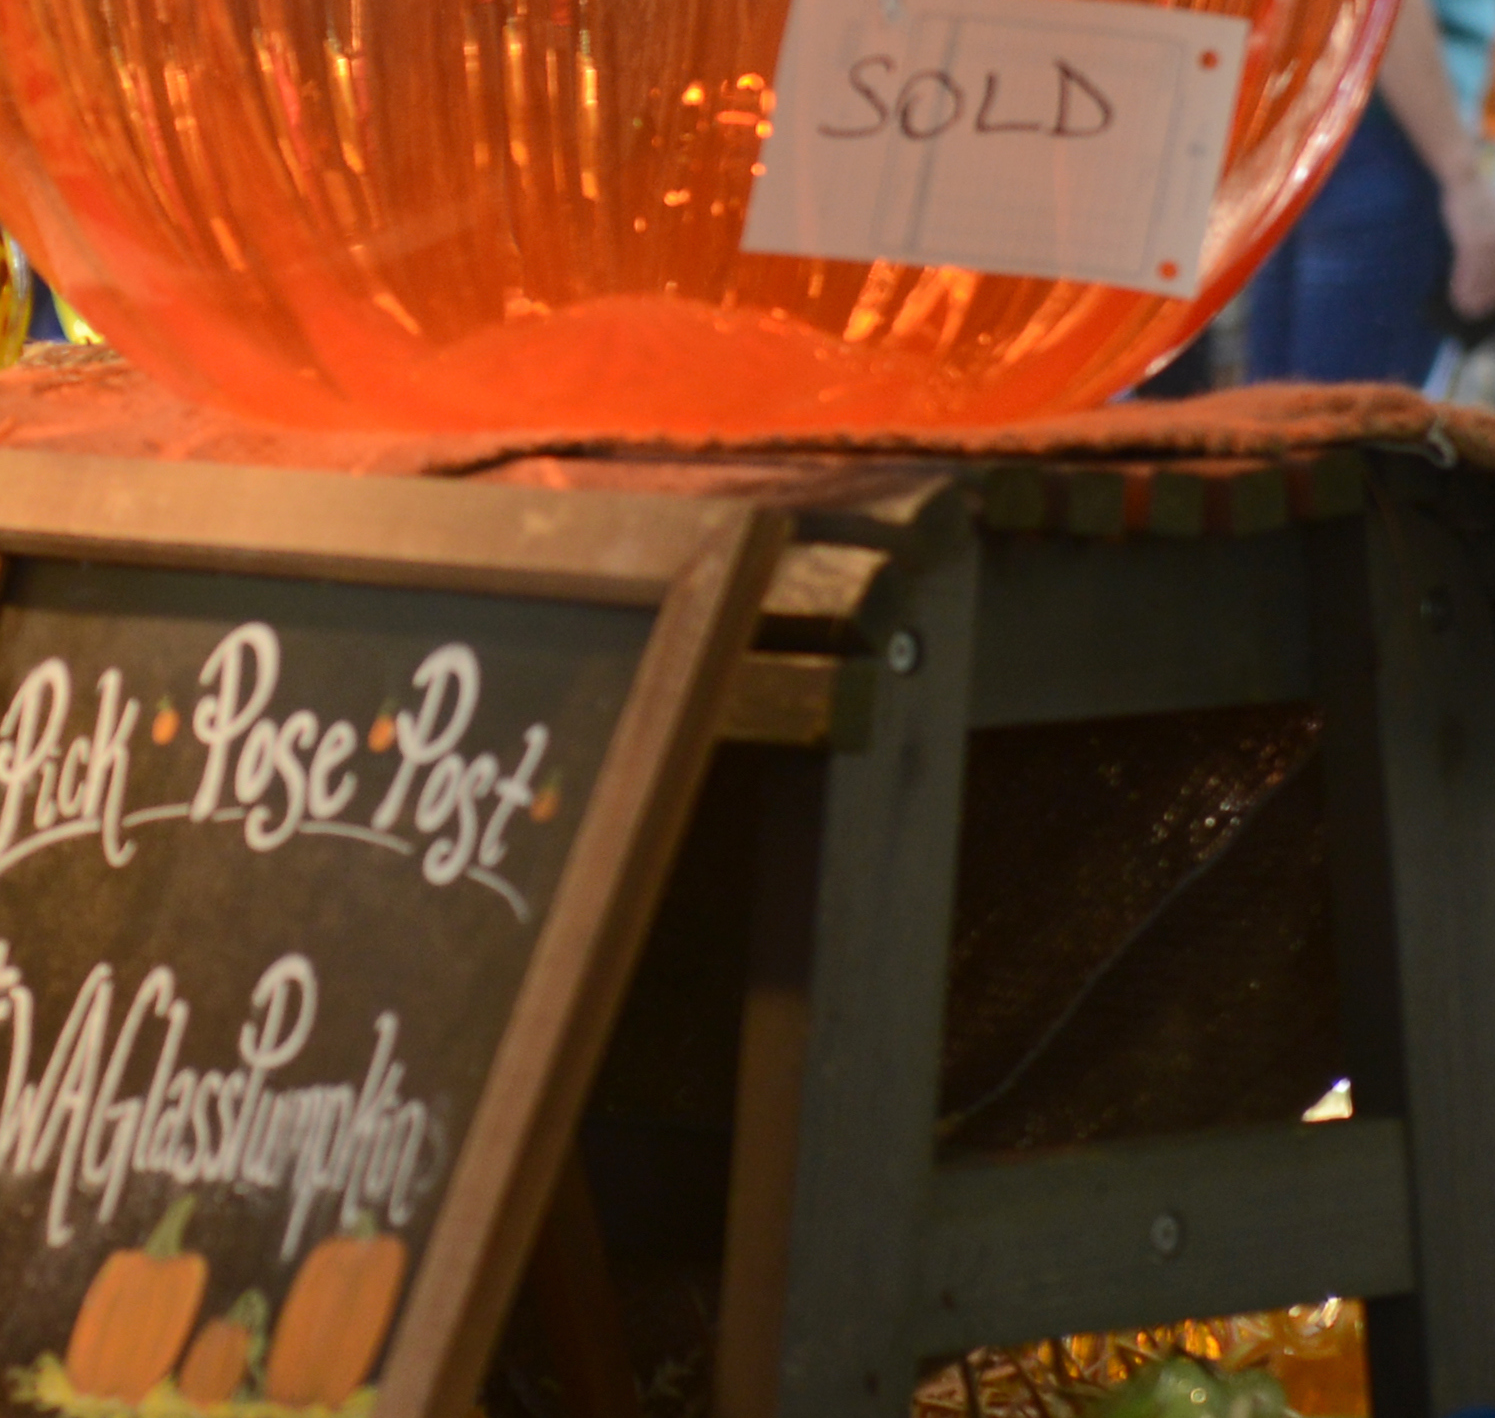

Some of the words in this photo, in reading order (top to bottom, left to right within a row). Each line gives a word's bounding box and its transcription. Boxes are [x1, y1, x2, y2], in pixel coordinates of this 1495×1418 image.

[817, 53, 1115, 141] SOLD
[192, 621, 360, 852] Pose
[370, 643, 550, 886] Post
